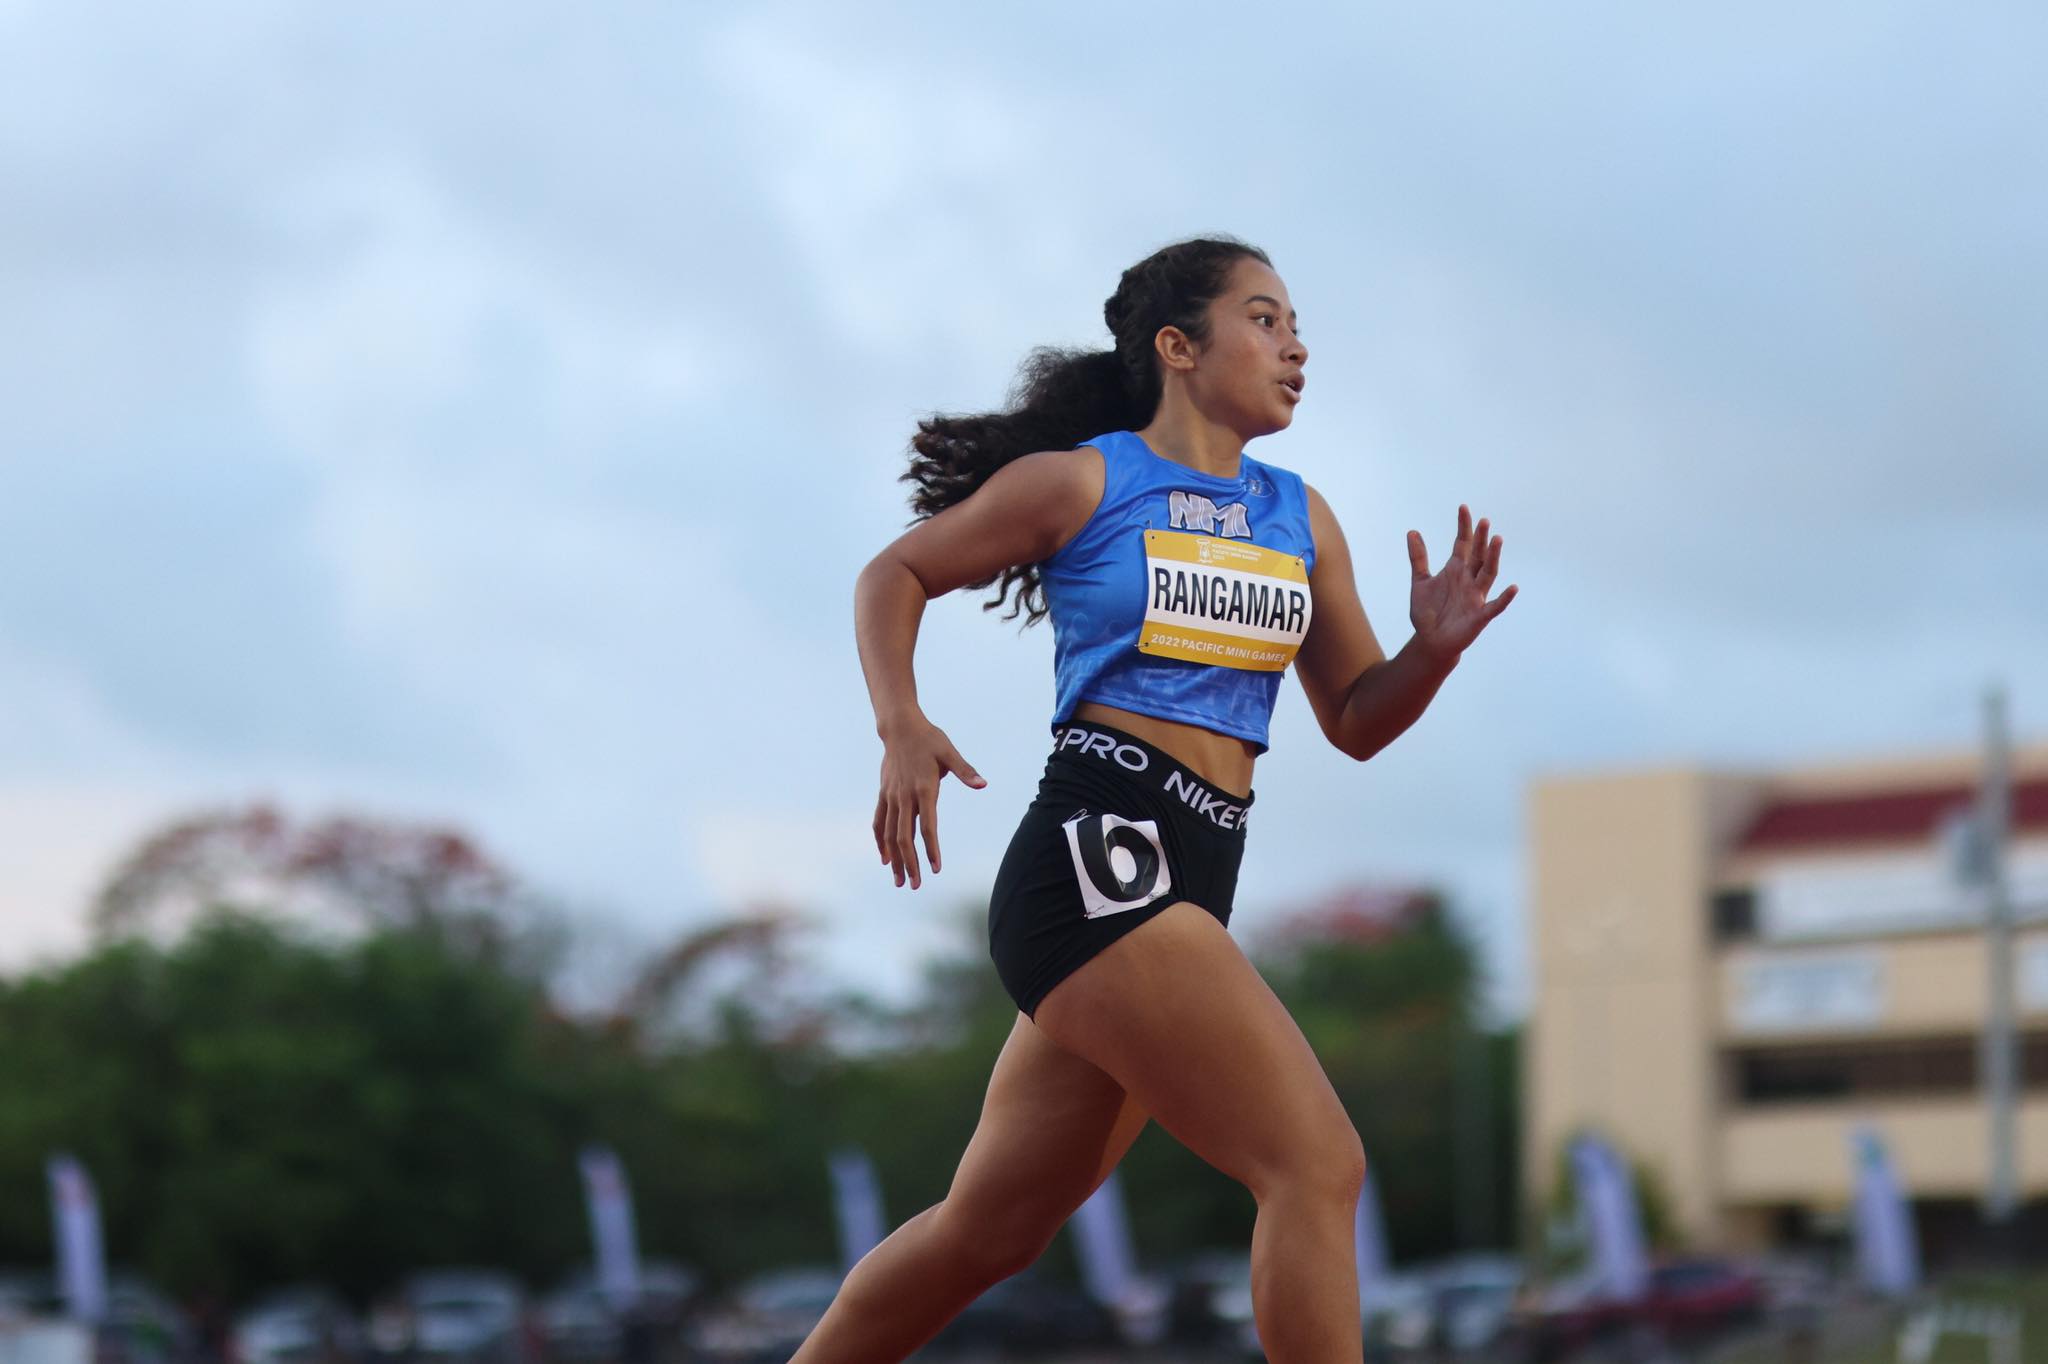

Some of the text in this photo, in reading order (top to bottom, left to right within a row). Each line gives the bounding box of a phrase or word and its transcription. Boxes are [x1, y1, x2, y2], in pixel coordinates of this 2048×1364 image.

[1168, 490, 1253, 539] NMI
[1154, 567, 1306, 633] RANGAMAR
[1151, 633, 1286, 662] 2022 PACIFIC MINI GAMES
[1076, 814, 1160, 903] 6
